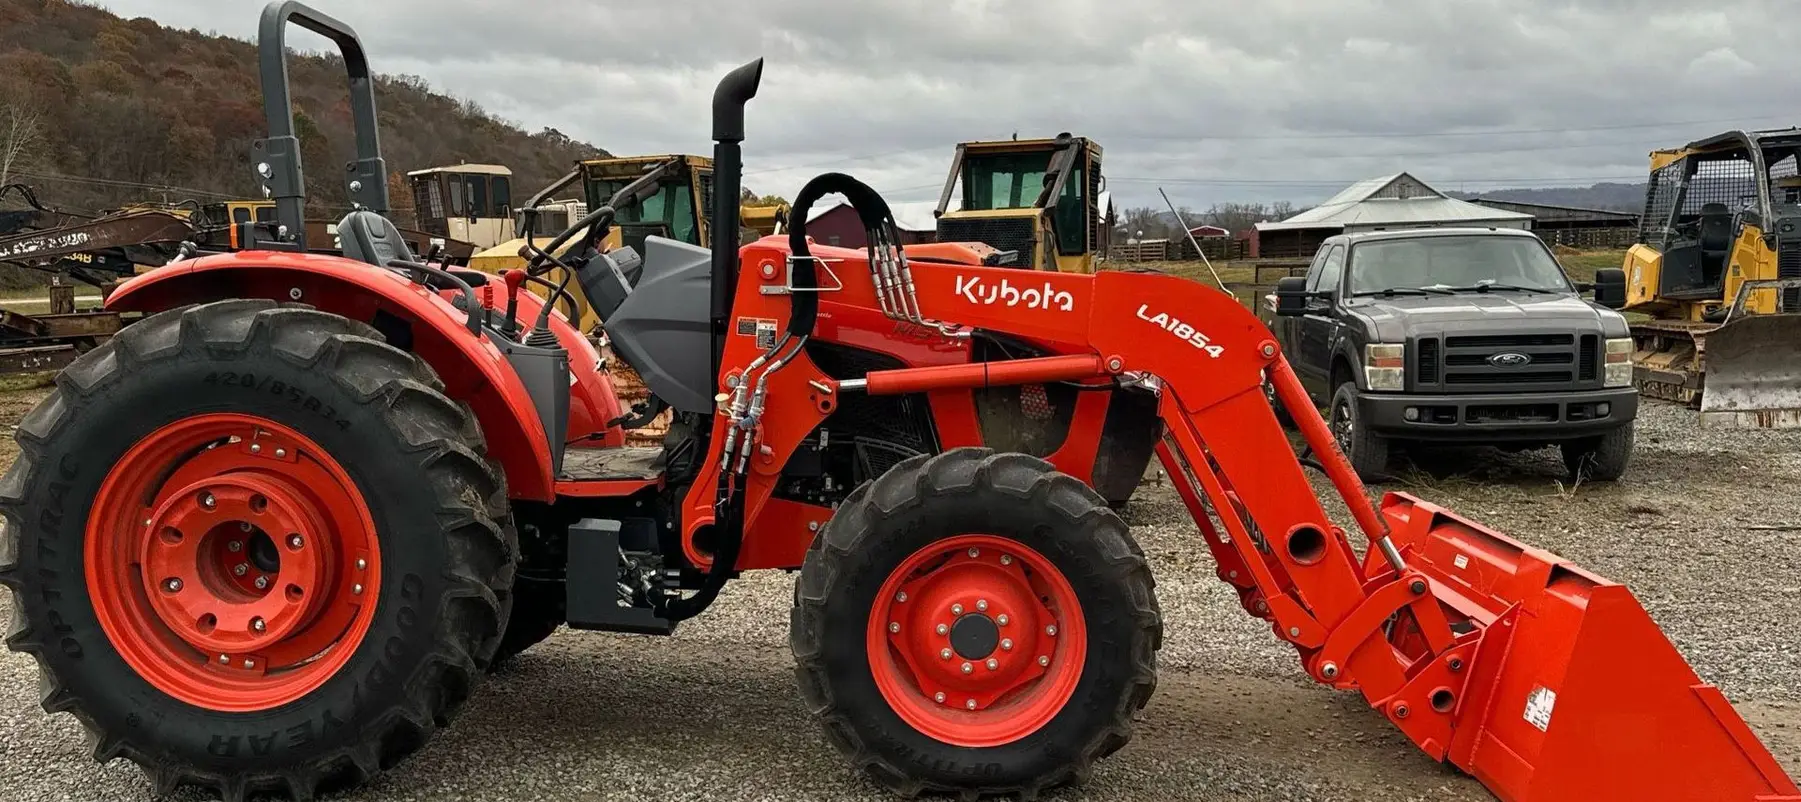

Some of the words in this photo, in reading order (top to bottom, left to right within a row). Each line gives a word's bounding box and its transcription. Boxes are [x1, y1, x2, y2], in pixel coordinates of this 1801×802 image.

[955, 275, 1074, 312] Kubota
[1135, 303, 1225, 358] LA1854
[37, 452, 84, 658] OPTITRAC
